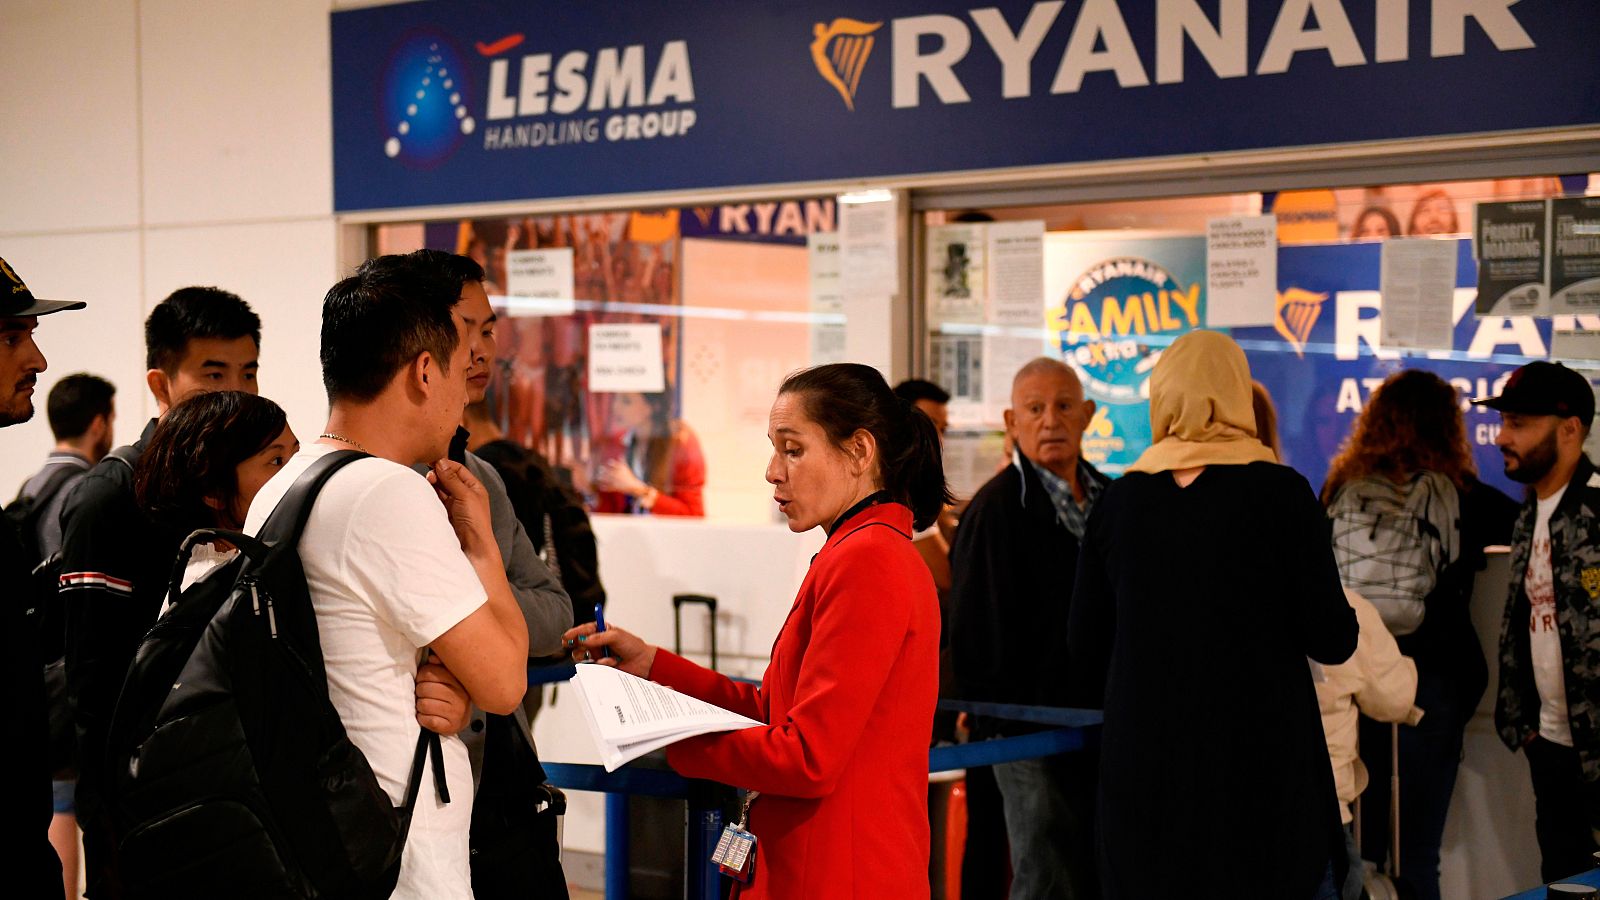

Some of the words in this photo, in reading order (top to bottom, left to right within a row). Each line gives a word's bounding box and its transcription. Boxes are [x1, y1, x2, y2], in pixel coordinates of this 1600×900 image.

[486, 39, 696, 120] LESMA
[892, 0, 1537, 109] RYANAIR
[484, 117, 600, 150] HANDLING
[604, 109, 697, 142] GROUP
[1045, 282, 1202, 348] FAMILY
